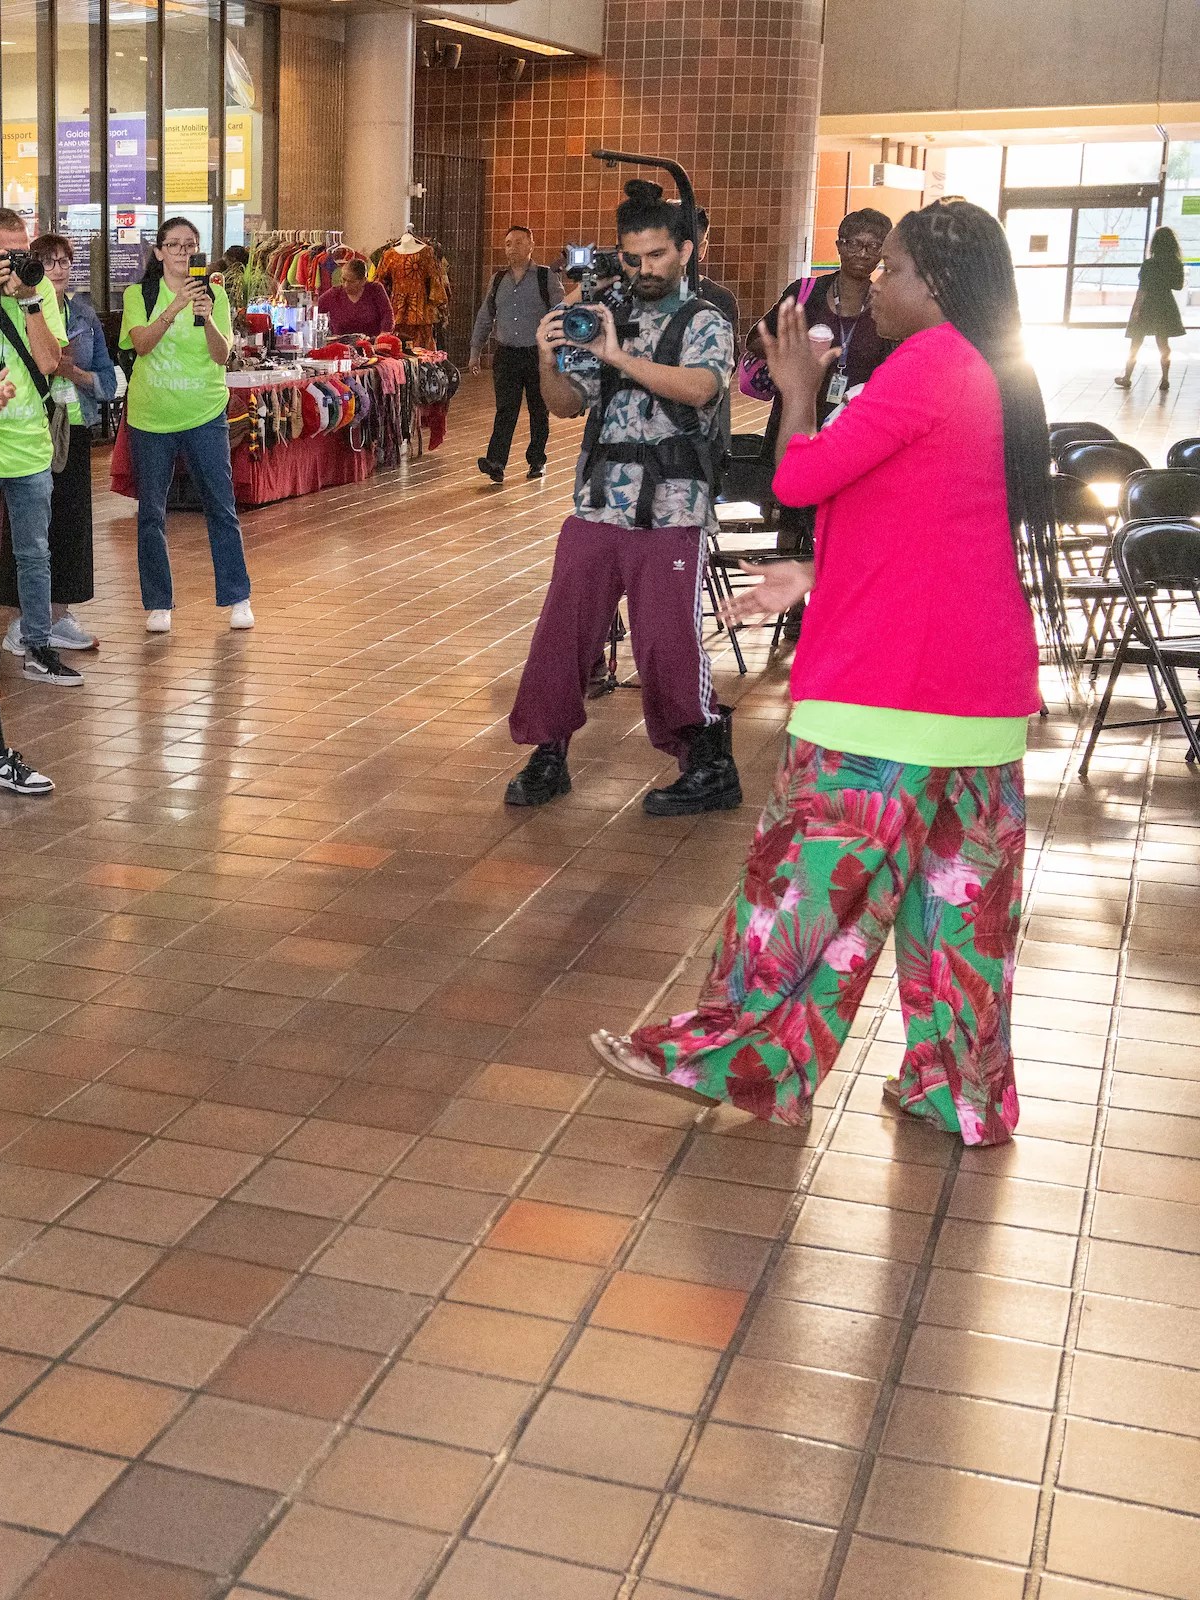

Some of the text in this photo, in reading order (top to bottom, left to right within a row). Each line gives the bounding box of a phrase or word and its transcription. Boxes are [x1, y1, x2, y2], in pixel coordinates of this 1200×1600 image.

[182, 124, 208, 132] Mobility
[227, 122, 244, 130] Card
[2, 132, 32, 141] assport
[109, 129, 128, 137] sport
[67, 217, 133, 226] Patrio port
